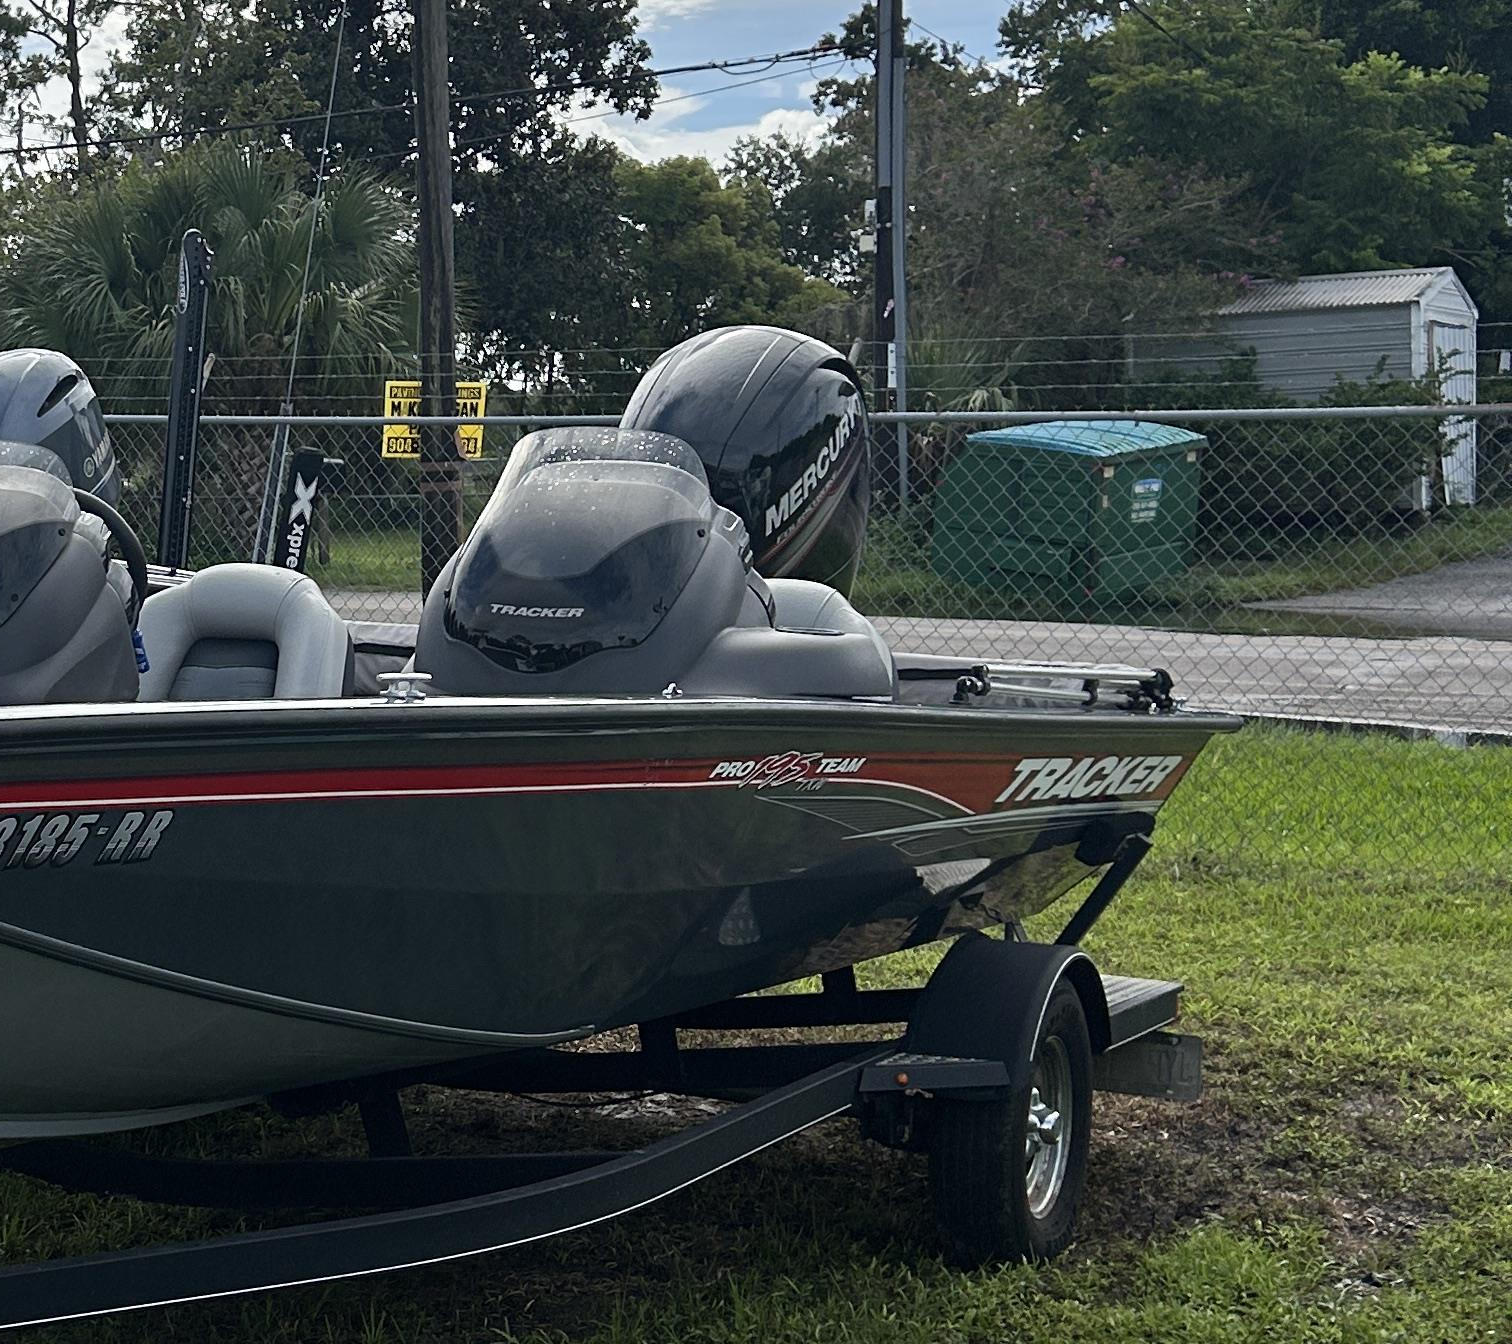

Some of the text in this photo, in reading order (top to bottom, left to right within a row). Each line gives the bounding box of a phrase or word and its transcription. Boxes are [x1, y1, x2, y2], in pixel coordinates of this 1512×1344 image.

[765, 393, 861, 537] MERCURY
[285, 523, 306, 569] xpre
[490, 603, 585, 618] TRACKER
[709, 750, 867, 790] PRO 195 TEAM
[994, 755, 1183, 803] TRACKER
